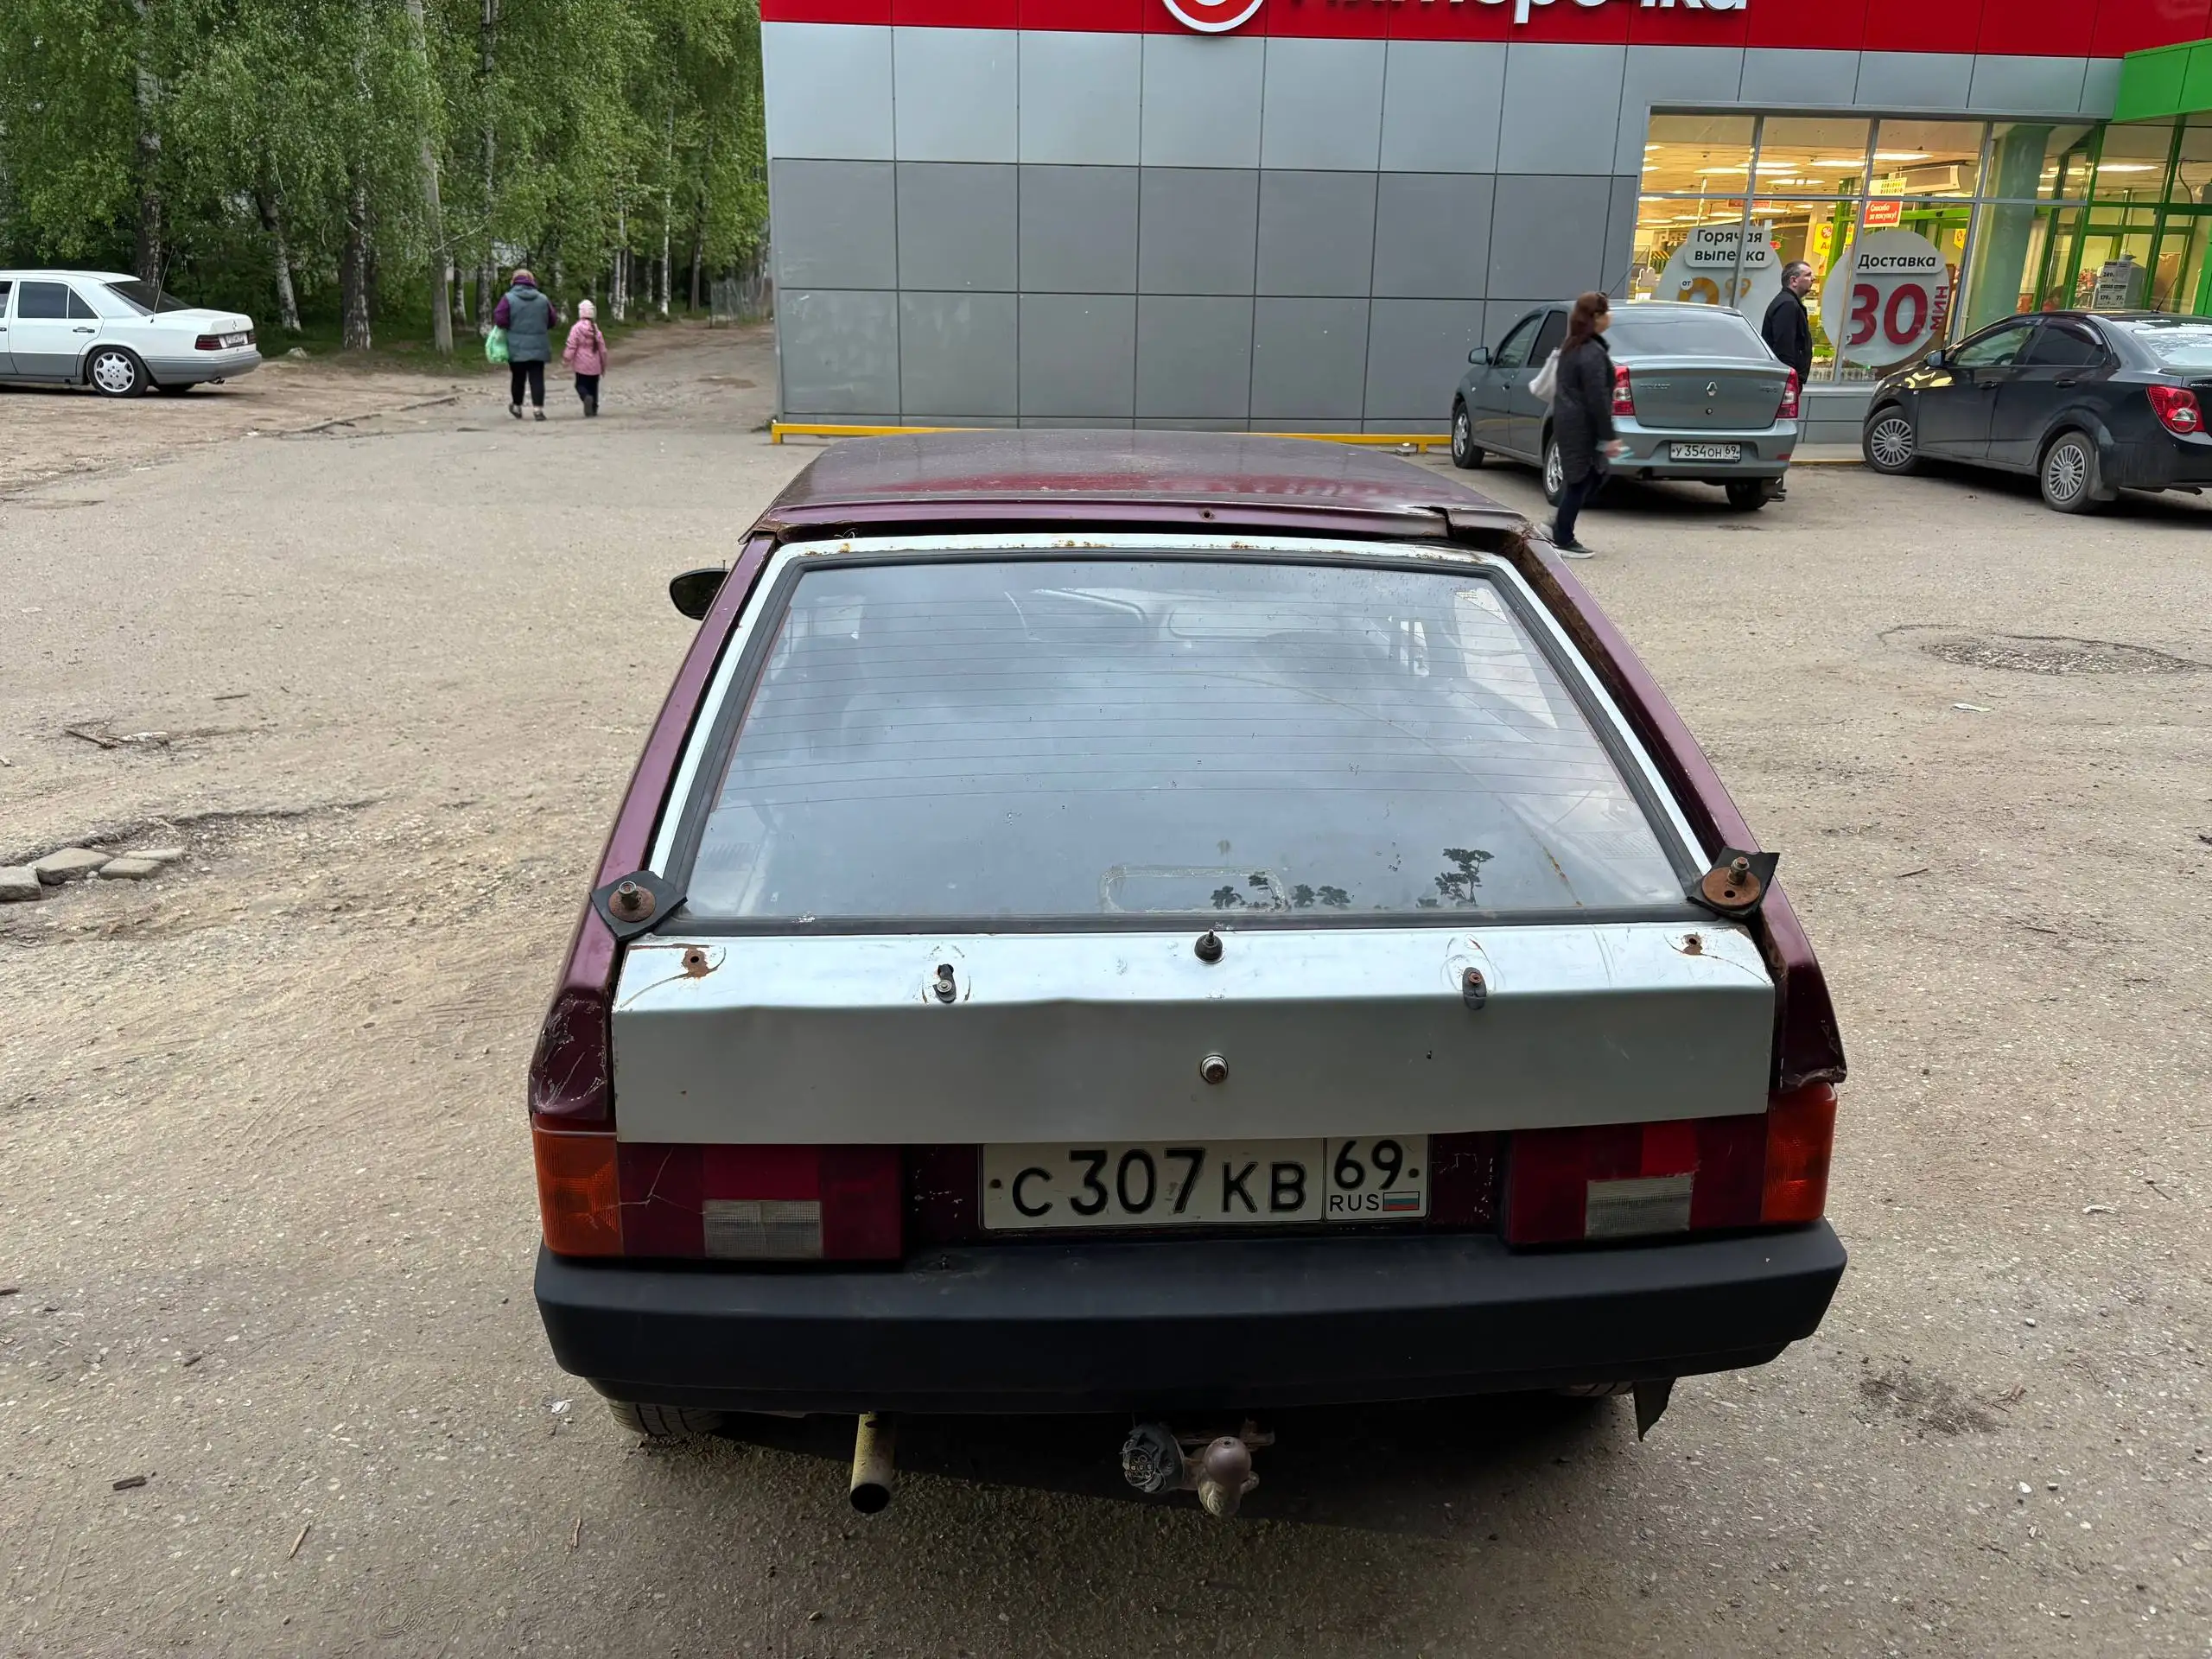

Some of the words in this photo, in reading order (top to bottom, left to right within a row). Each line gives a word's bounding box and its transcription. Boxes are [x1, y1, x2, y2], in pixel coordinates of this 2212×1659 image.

[1694, 251, 1764, 262] выпека
[1858, 254, 1936, 269] Доставка
[1851, 283, 1928, 345] 30
[1726, 445, 1737, 454] 69
[1333, 1140, 1403, 1190] 69
[1329, 1194, 1380, 1212] RUS
